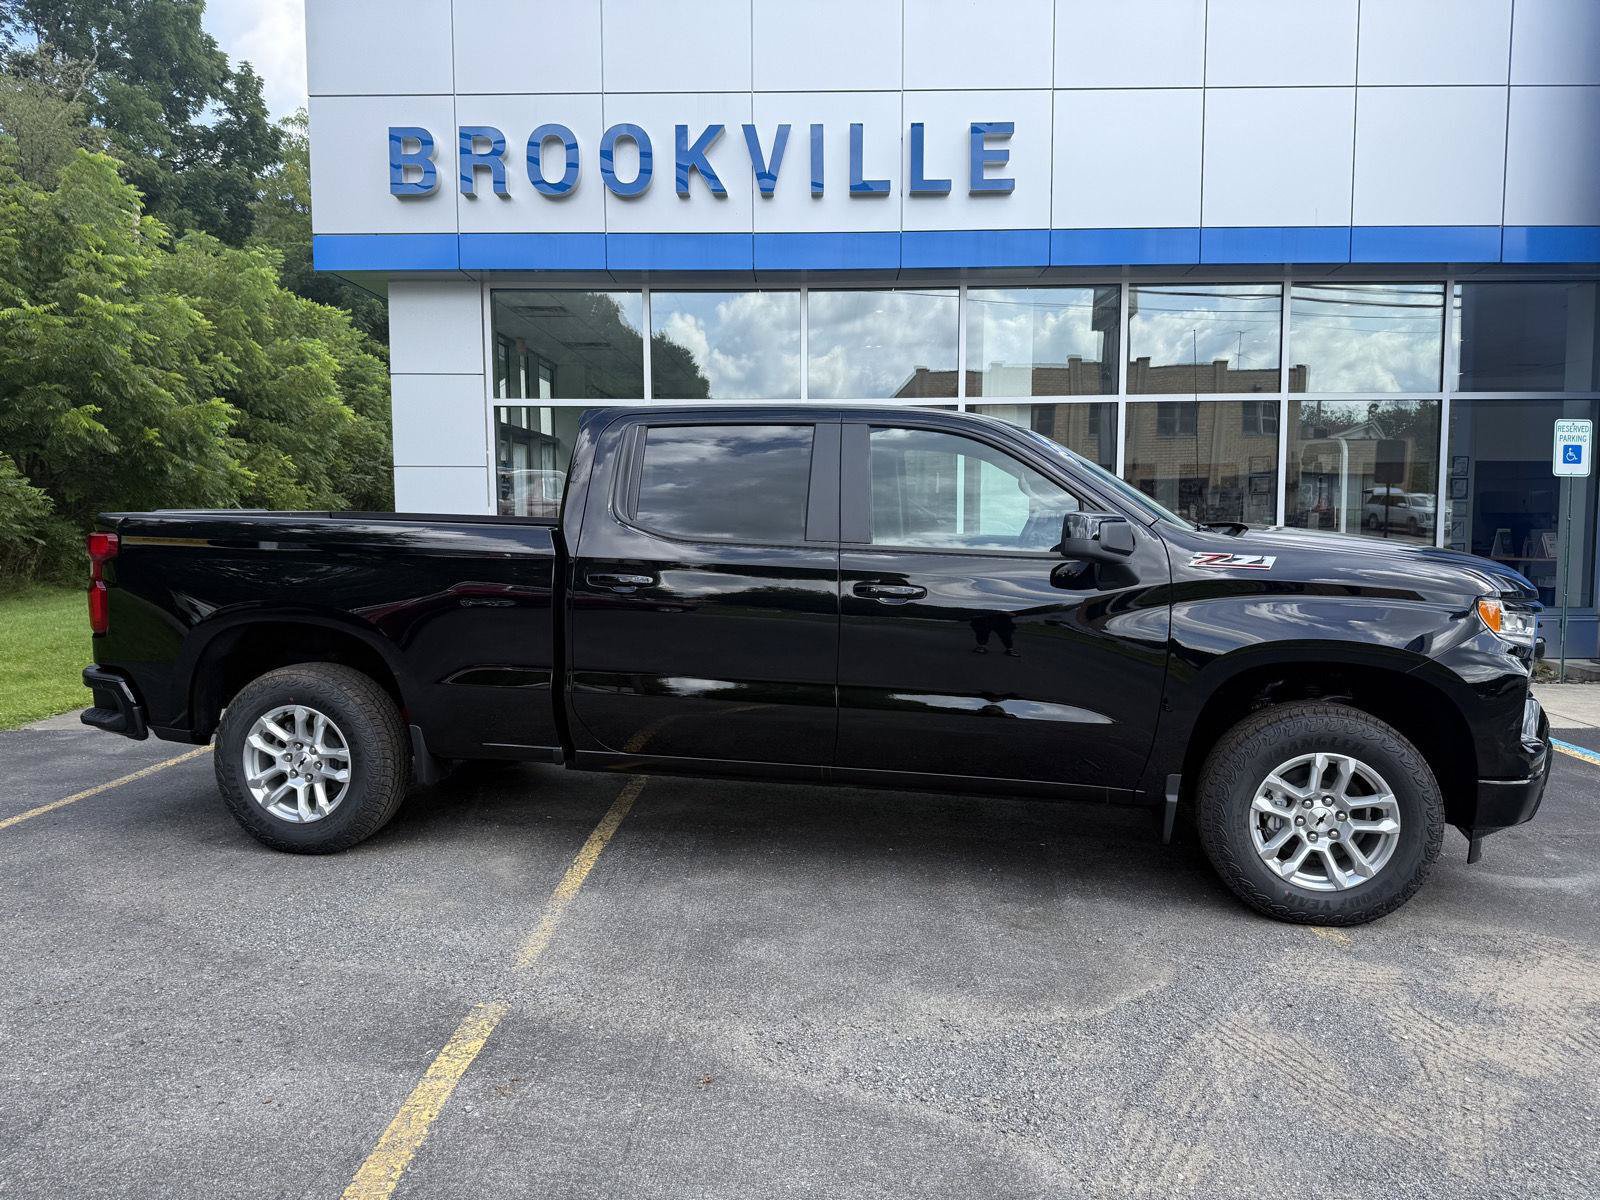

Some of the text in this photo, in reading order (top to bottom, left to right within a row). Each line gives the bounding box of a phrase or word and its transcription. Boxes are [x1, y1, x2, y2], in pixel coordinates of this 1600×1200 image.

[388, 121, 1016, 199] BROOKVILLE
[1557, 425, 1590, 433] RESERVED
[1559, 434, 1587, 442] PARKING
[1188, 552, 1277, 571] Z71
